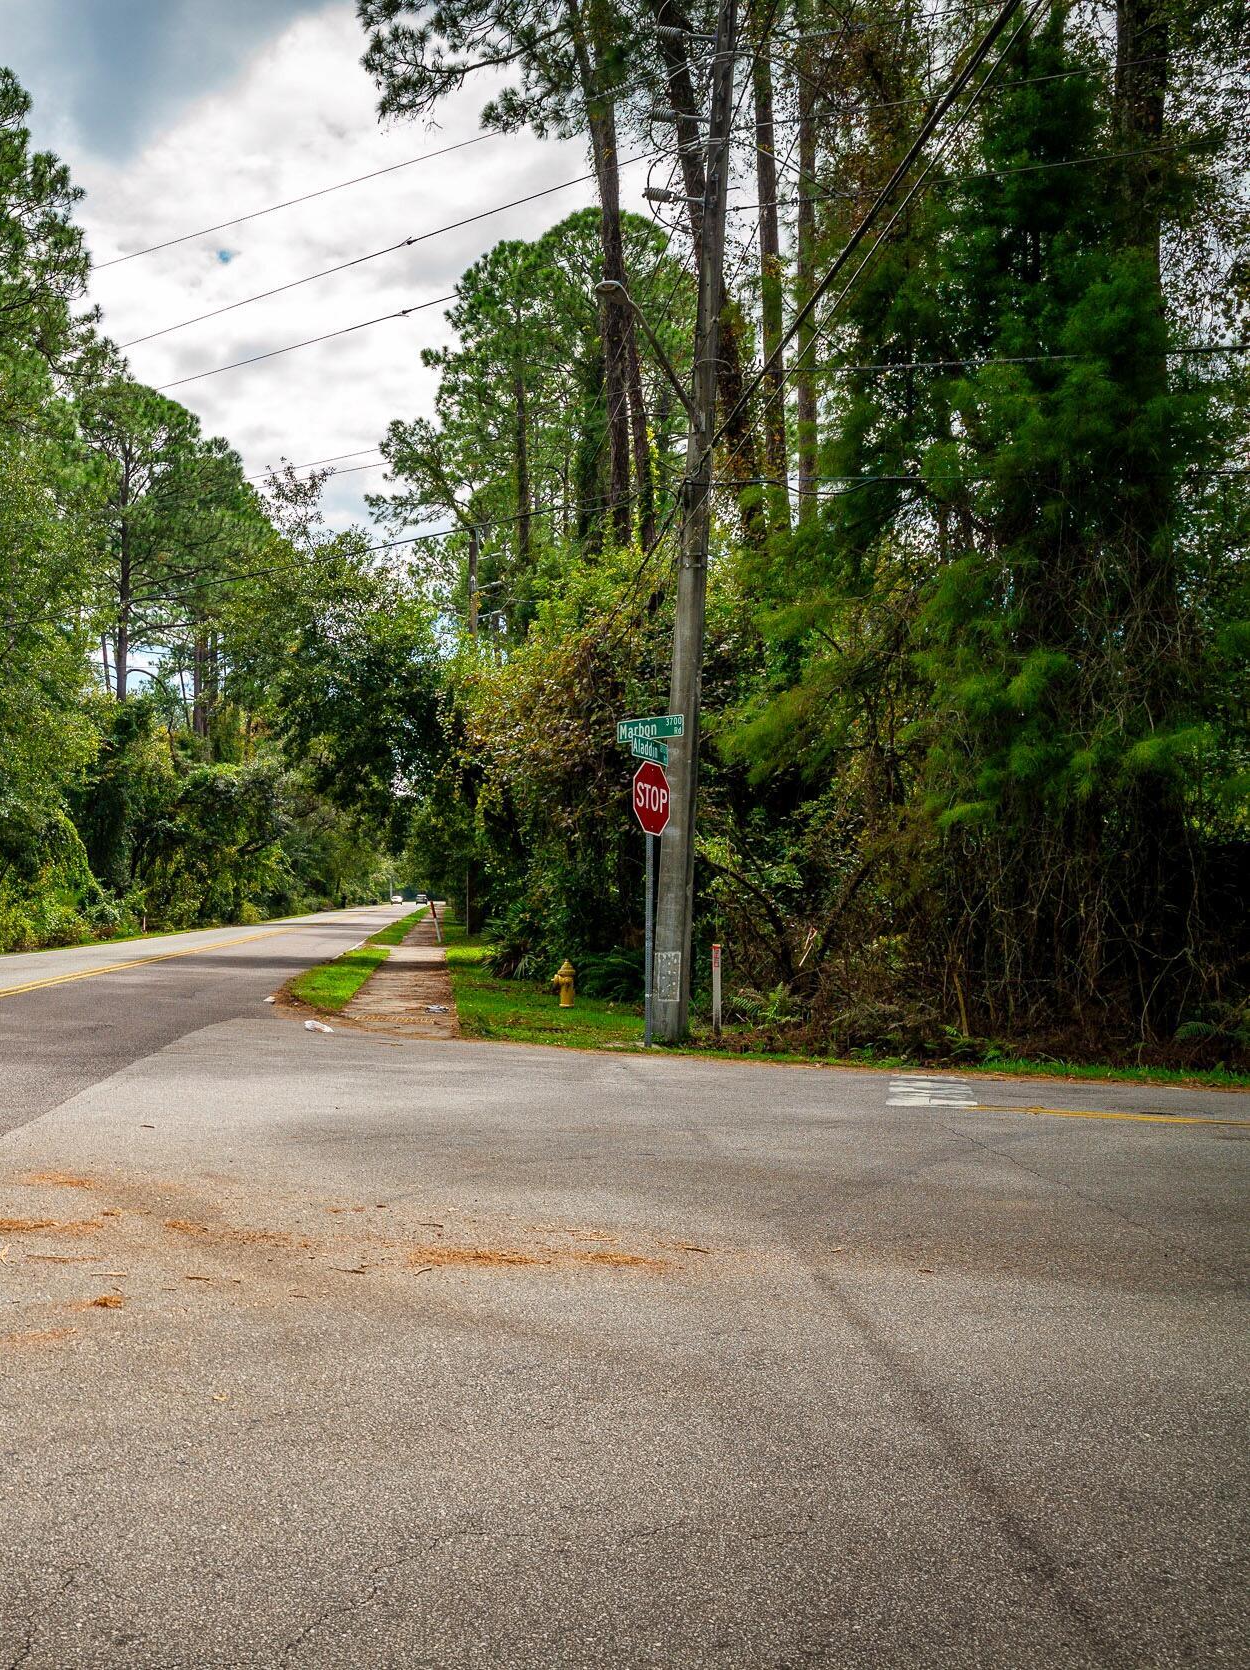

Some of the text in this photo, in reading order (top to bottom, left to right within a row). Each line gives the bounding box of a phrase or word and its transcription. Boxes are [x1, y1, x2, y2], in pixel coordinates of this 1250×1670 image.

[665, 716, 682, 726] 3700
[619, 722, 657, 740] Marbon
[673, 726, 682, 735] Rd
[633, 737, 658, 759] Aladdin
[636, 781, 668, 814] STOP
